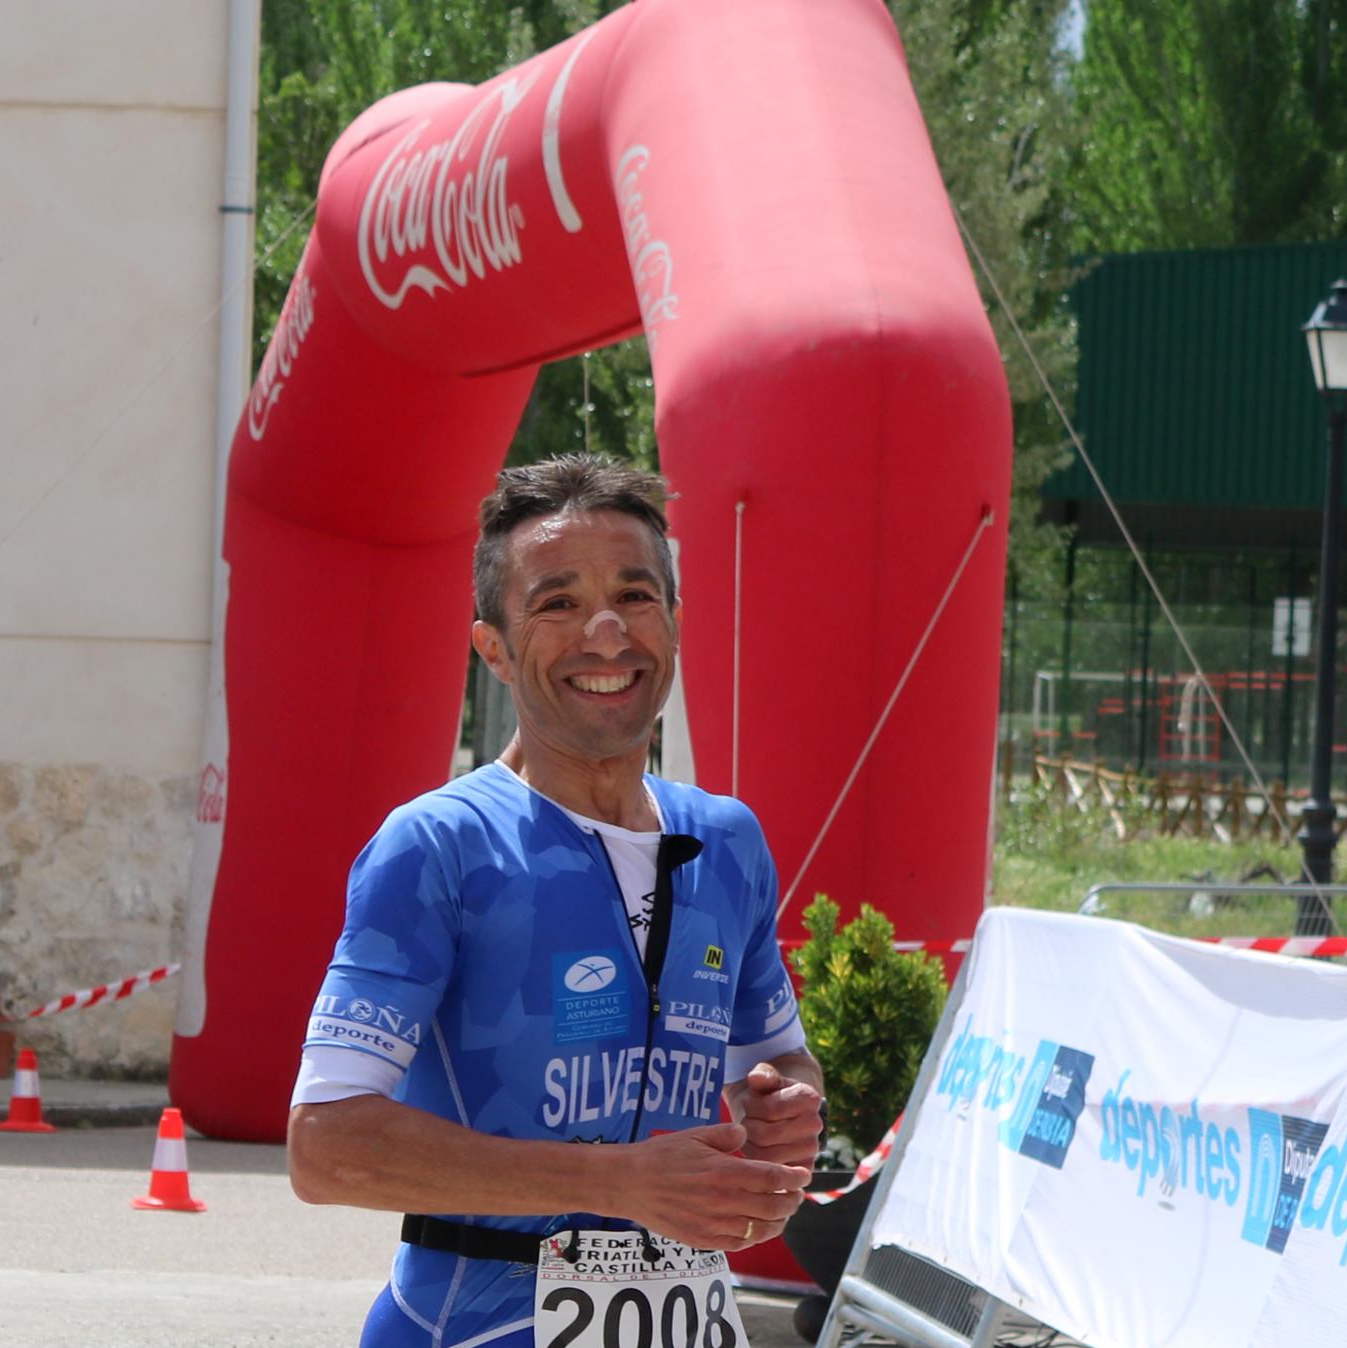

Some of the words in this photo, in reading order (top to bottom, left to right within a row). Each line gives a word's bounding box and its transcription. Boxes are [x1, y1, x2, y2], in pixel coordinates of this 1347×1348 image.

[706, 949, 721, 966] IN
[566, 996, 620, 1010] DEPORTE
[312, 1021, 396, 1052] deporte
[542, 1047, 720, 1128] SILVESTRE
[1099, 1069, 1242, 1207] deportes
[574, 1261, 676, 1274] CASTILLA
[685, 1259, 695, 1269] Y
[541, 1273, 620, 1282] DORSAL
